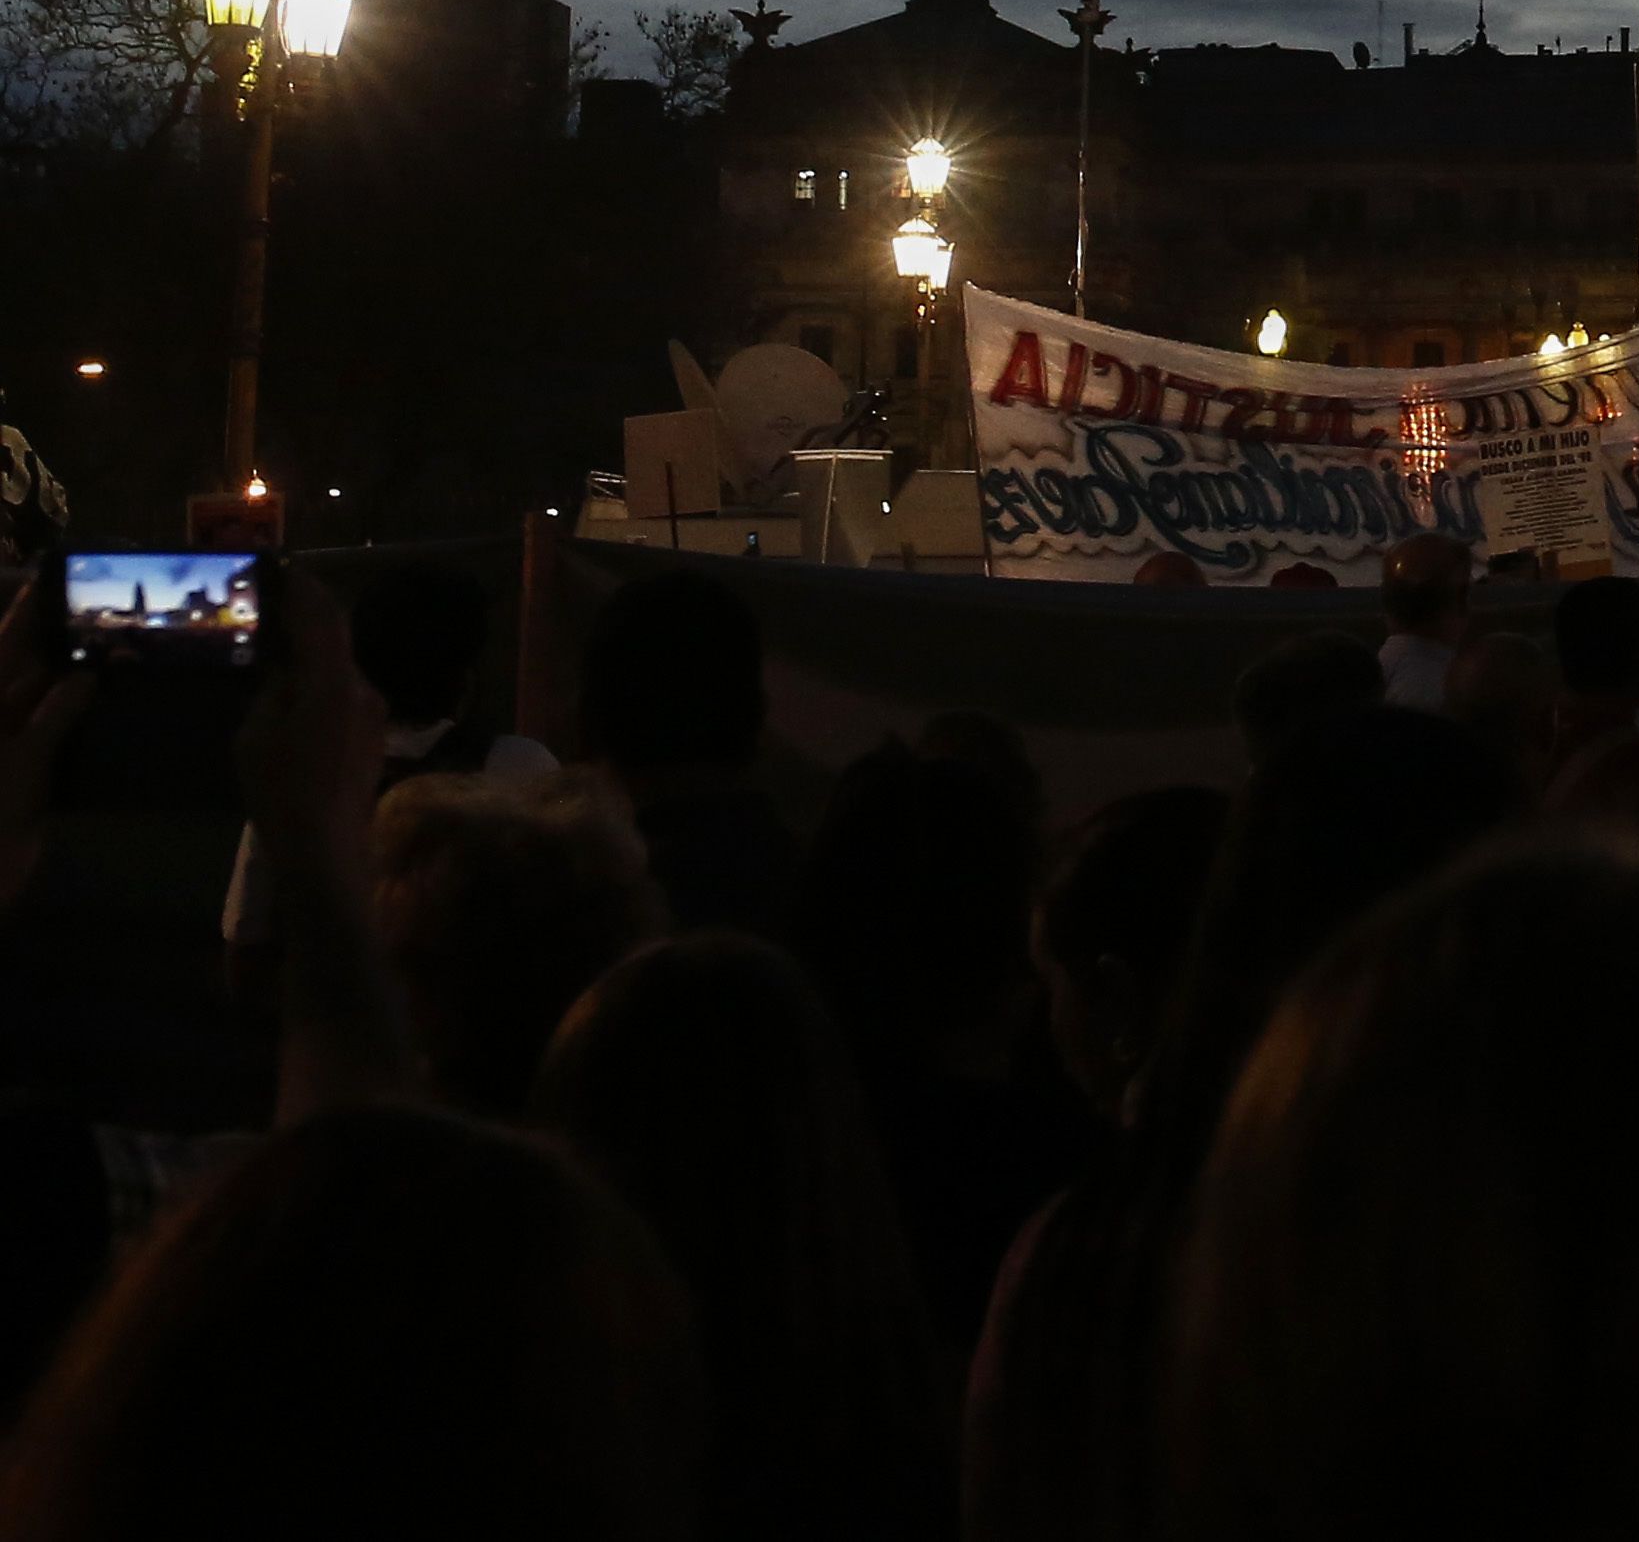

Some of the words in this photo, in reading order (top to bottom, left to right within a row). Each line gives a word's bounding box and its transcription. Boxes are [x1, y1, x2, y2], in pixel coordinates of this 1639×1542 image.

[1480, 439, 1523, 460] BUSCO
[1526, 437, 1536, 454] A
[1539, 434, 1557, 451] MI
[1560, 430, 1590, 449] HIJO
